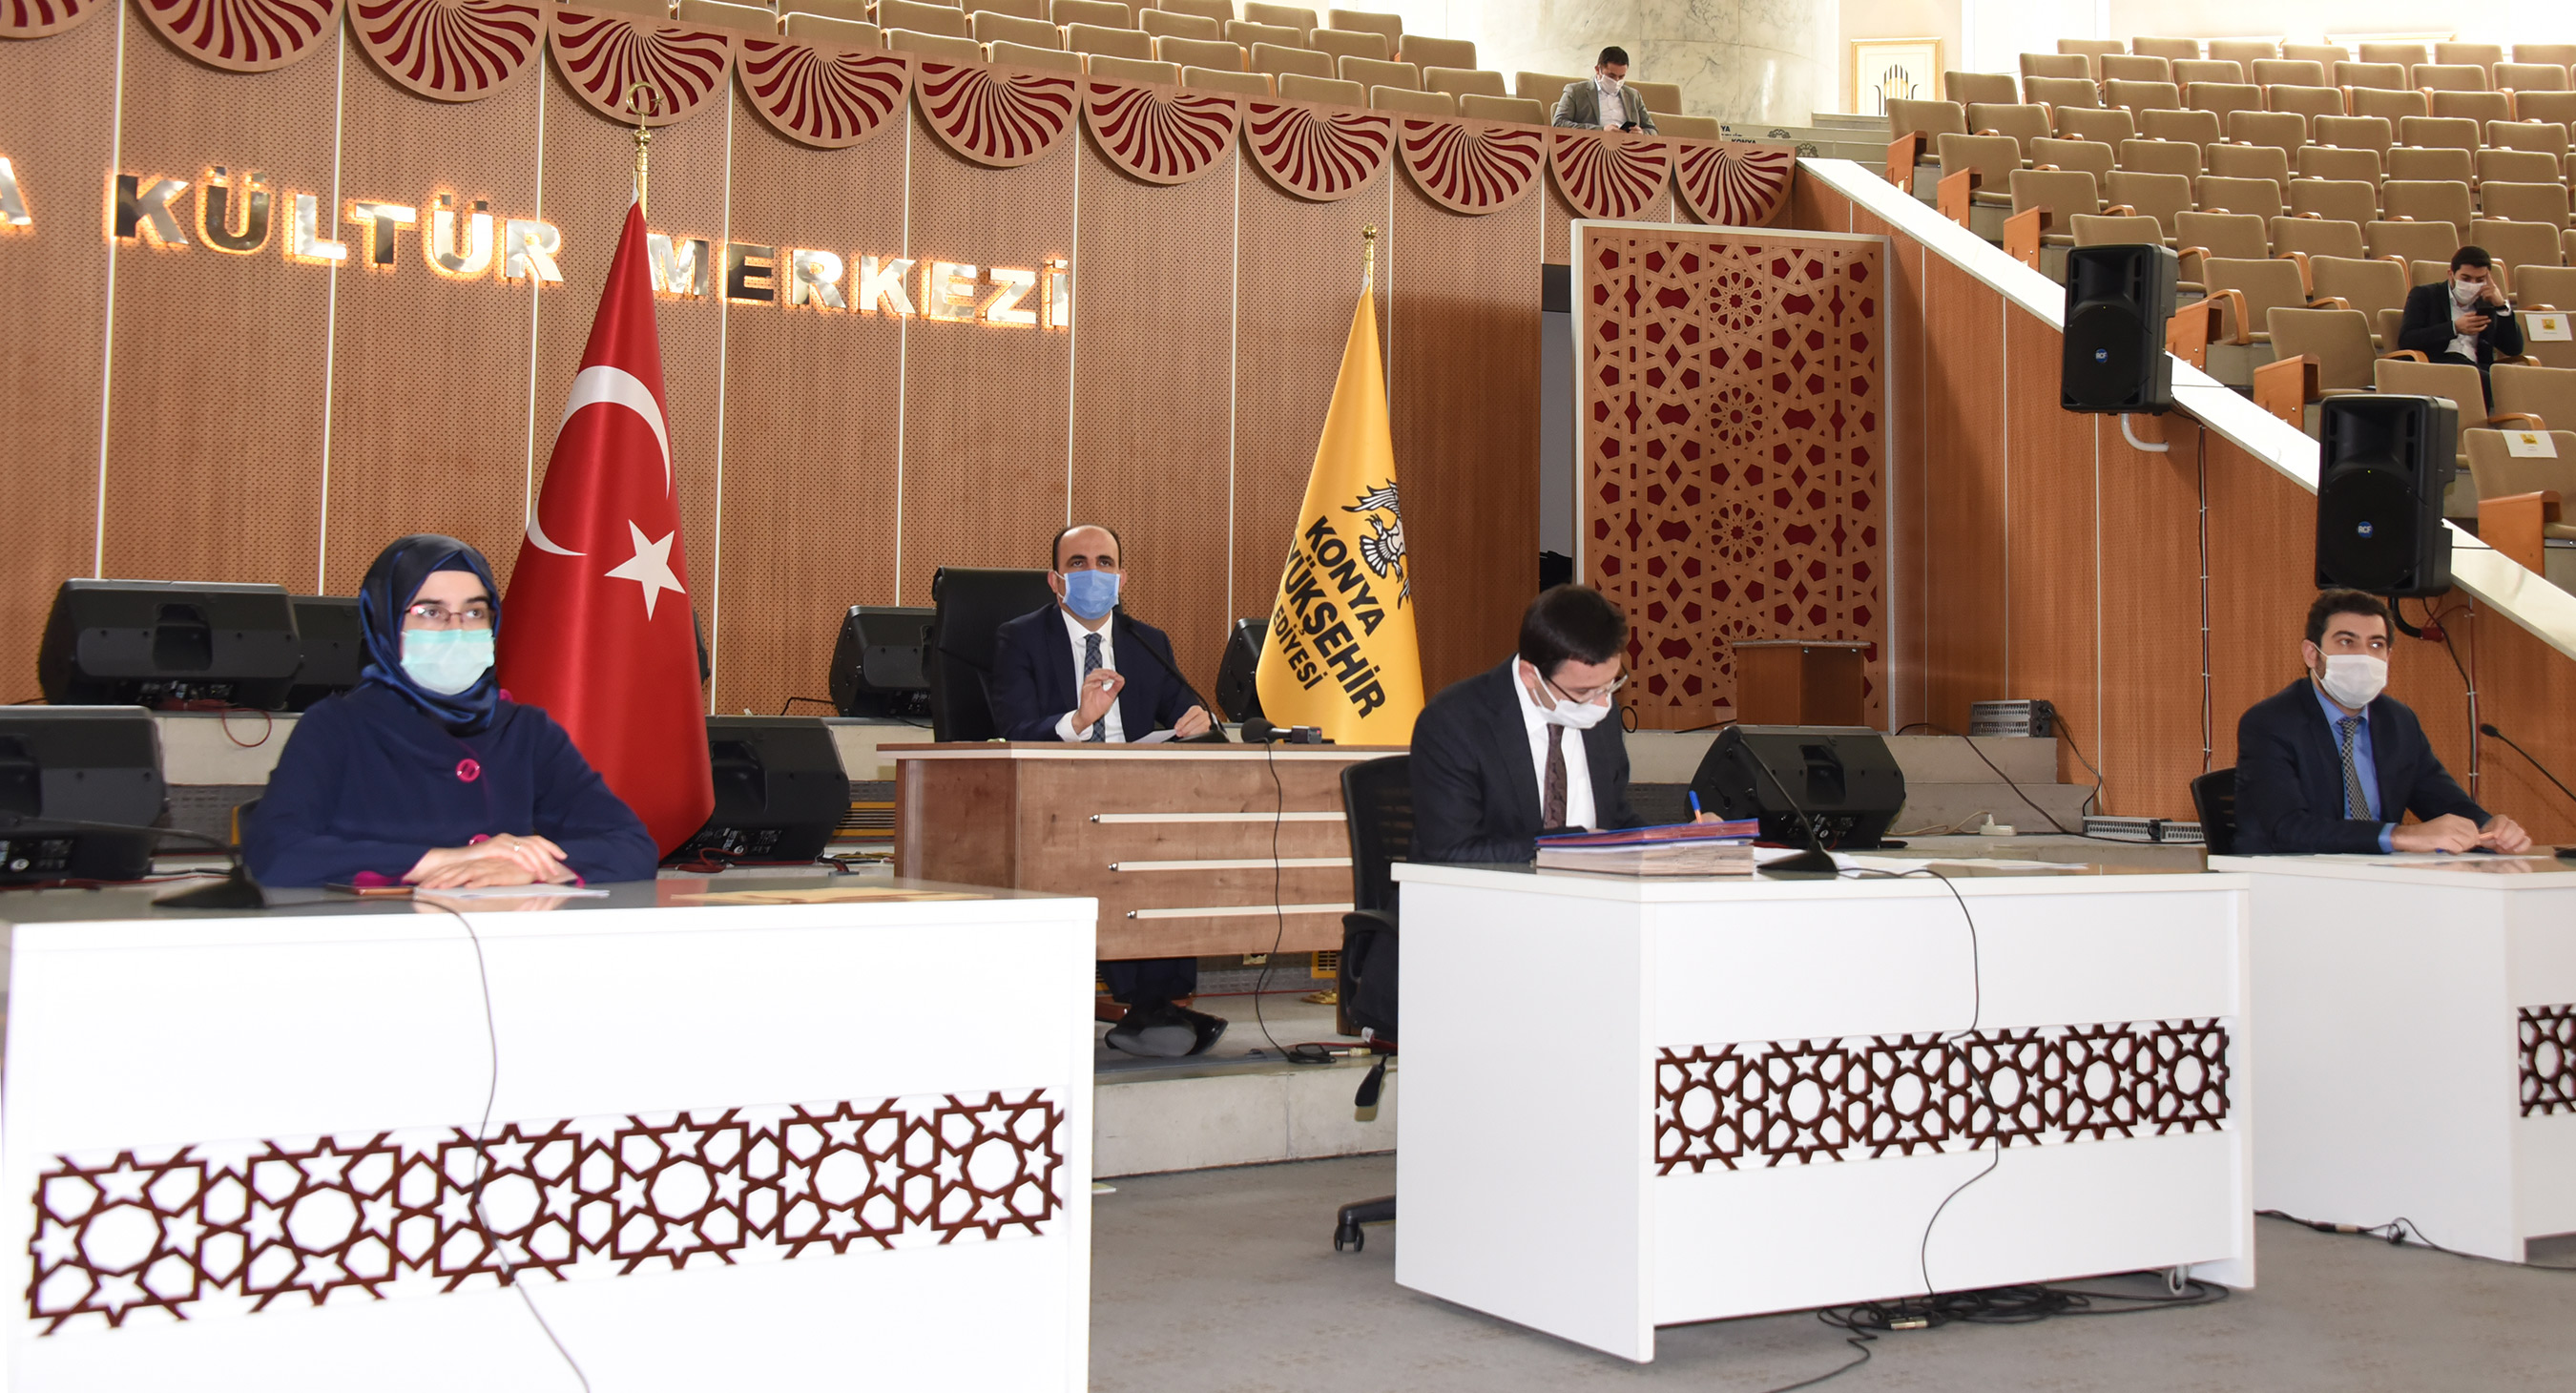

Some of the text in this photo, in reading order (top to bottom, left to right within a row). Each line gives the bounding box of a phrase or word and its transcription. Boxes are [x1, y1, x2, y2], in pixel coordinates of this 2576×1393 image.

[114, 165, 564, 282] KÜLTÜR
[647, 233, 1070, 326] MERKEZİ
[1304, 514, 1385, 637] KONYA
